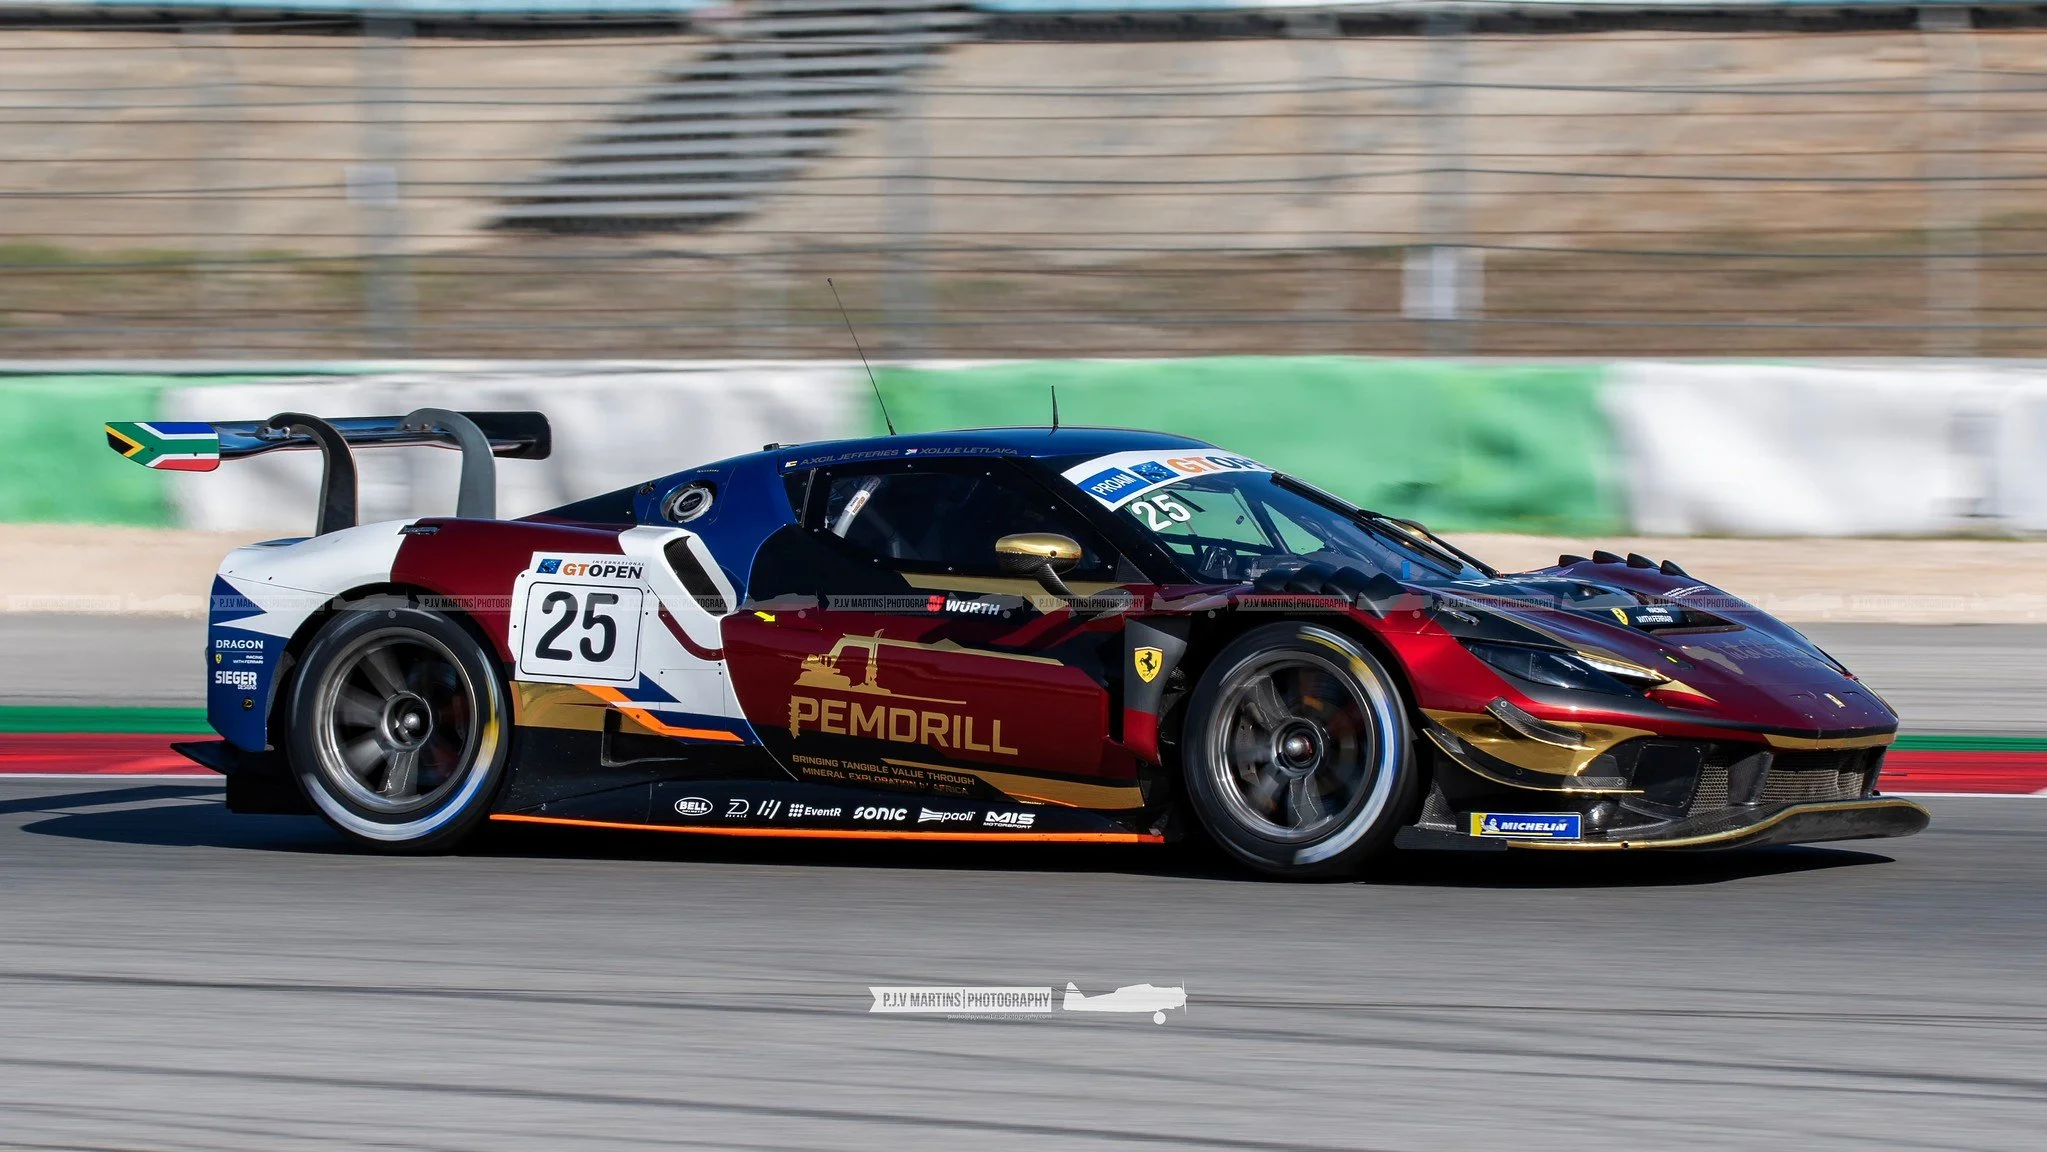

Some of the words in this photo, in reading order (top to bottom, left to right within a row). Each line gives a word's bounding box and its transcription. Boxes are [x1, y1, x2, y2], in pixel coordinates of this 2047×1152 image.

[836, 450, 900, 461] JEFFERIES
[1091, 473, 1136, 496] PROAM
[1131, 494, 1192, 532] 25
[946, 600, 1000, 616] WÜRTH
[535, 591, 619, 662] 25
[216, 640, 264, 649] DRAGON
[215, 671, 257, 686] SIEGER
[788, 695, 1018, 756] PEMDRILL
[792, 754, 839, 768] BRINGING
[842, 760, 889, 774] TANGIBLE
[891, 768, 924, 779] VALUE
[926, 771, 975, 786] THROUGH
[802, 766, 846, 779] MINERAL
[679, 801, 708, 811] BELL
[804, 806, 842, 817] EventR
[940, 811, 976, 823] paoli
[985, 811, 1036, 824] MIS
[1500, 822, 1568, 832] MICHELIN
